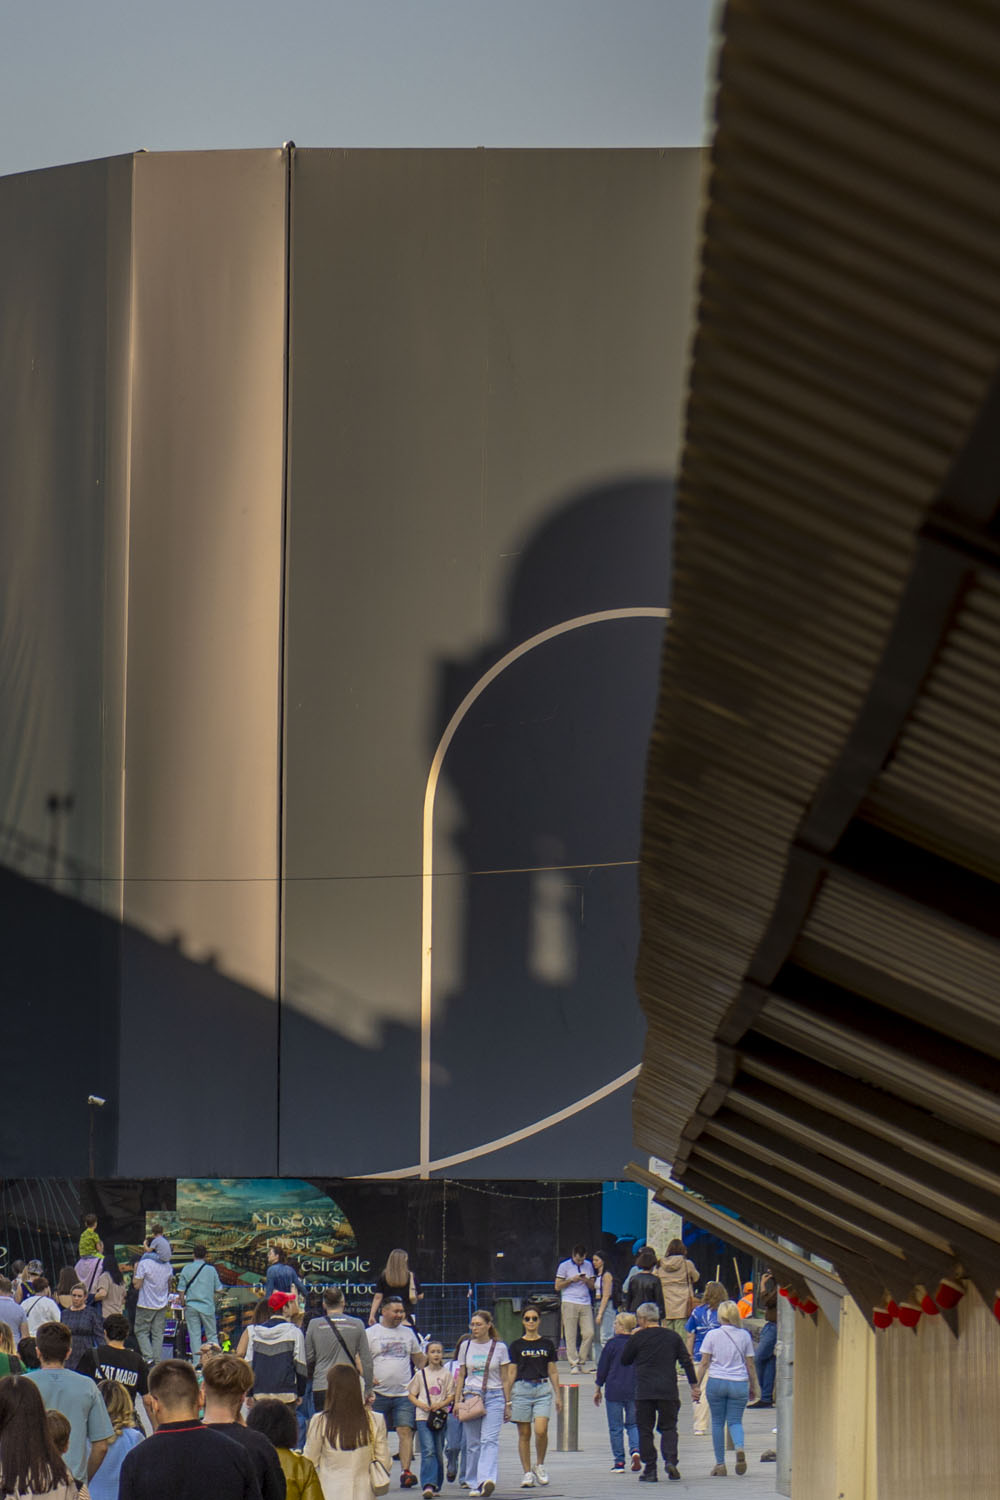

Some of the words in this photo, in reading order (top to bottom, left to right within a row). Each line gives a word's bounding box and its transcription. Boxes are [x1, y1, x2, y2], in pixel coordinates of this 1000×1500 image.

[252, 1212, 340, 1227] Moscow's
[266, 1237, 312, 1249] most
[297, 1256, 370, 1272] esirable
